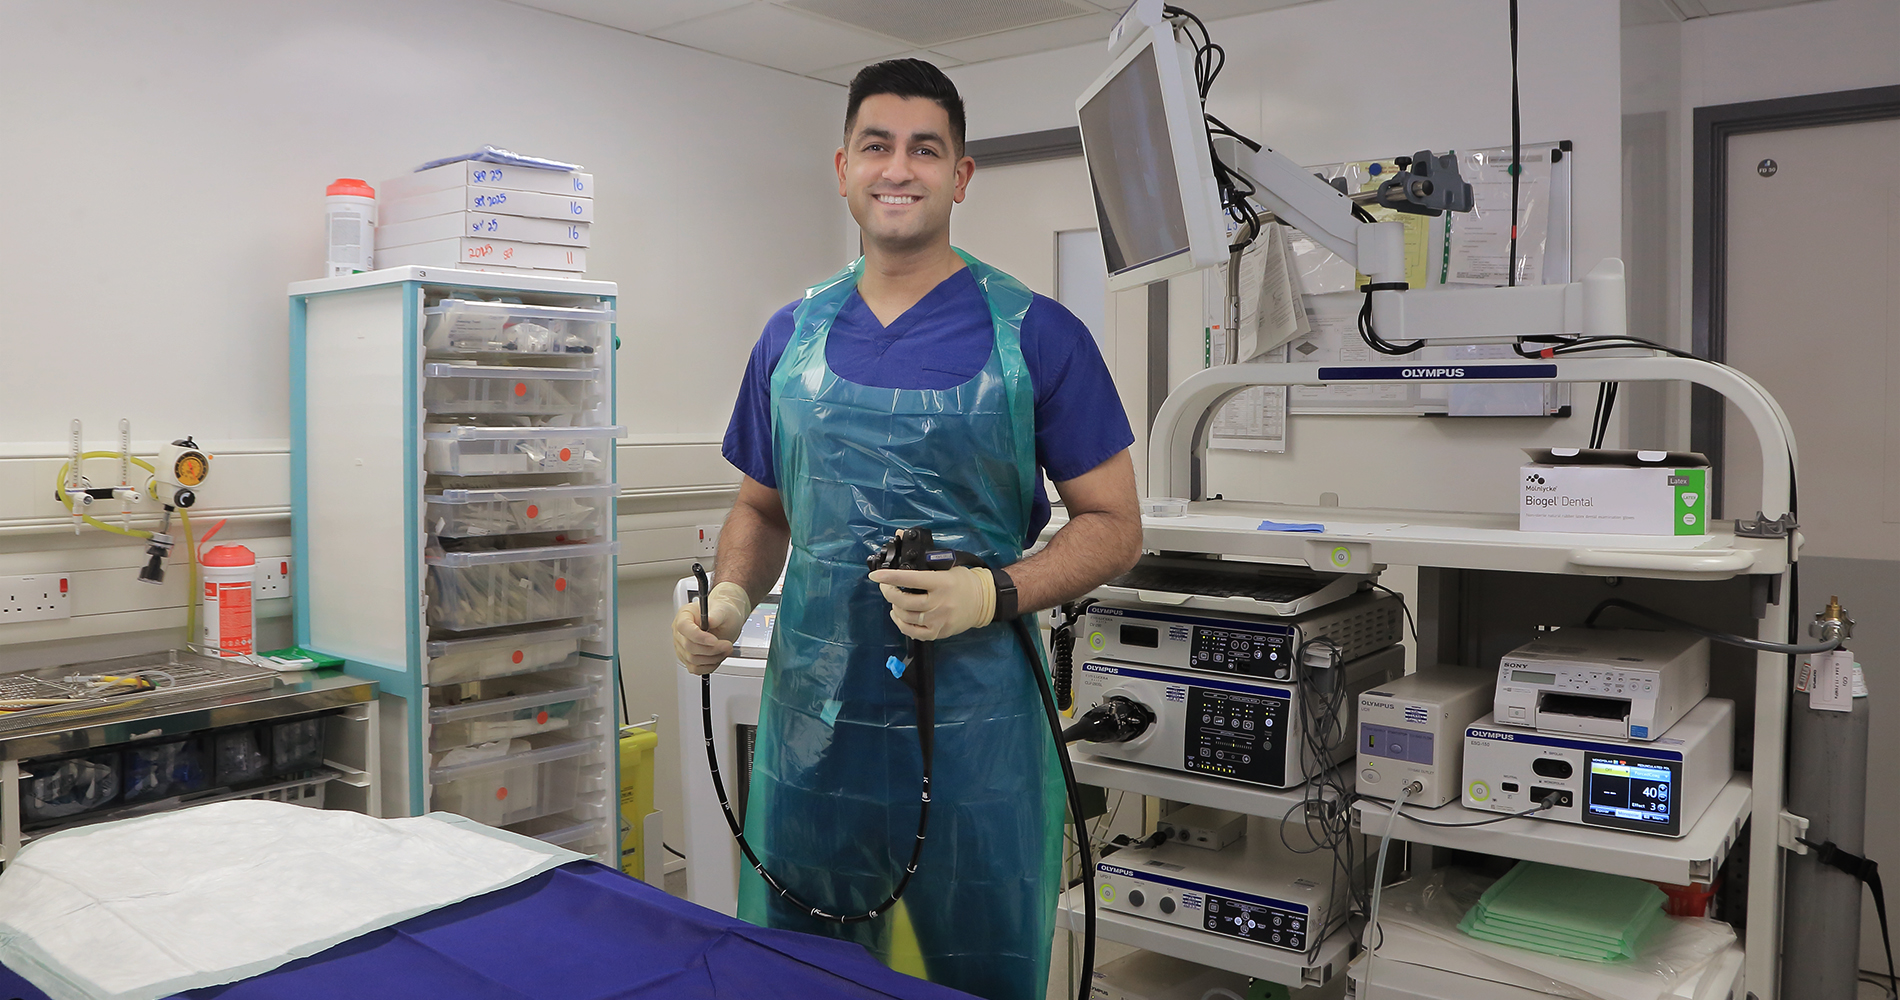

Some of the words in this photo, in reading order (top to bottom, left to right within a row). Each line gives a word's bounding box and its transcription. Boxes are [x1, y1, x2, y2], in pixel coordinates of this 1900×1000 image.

[573, 178, 584, 191] 16
[487, 193, 507, 207] 2025
[570, 201, 583, 215] 16
[487, 218, 498, 231] 25
[568, 225, 579, 239] 16
[468, 243, 493, 258] 2025
[566, 251, 574, 264] 11
[1402, 367, 1465, 378] OLYMPUS
[1525, 495, 1557, 508] Biogel
[1561, 496, 1594, 507] Dental
[1091, 607, 1124, 616] OLYMPUS
[1086, 664, 1119, 674] OLYMPUS
[1503, 662, 1529, 671] SONY
[1361, 700, 1395, 710] OLYMPUS
[1471, 730, 1515, 741] OLYMPUS
[1642, 786, 1658, 799] 40
[1650, 802, 1657, 811] 3
[1100, 864, 1134, 877] OLYMPUS
